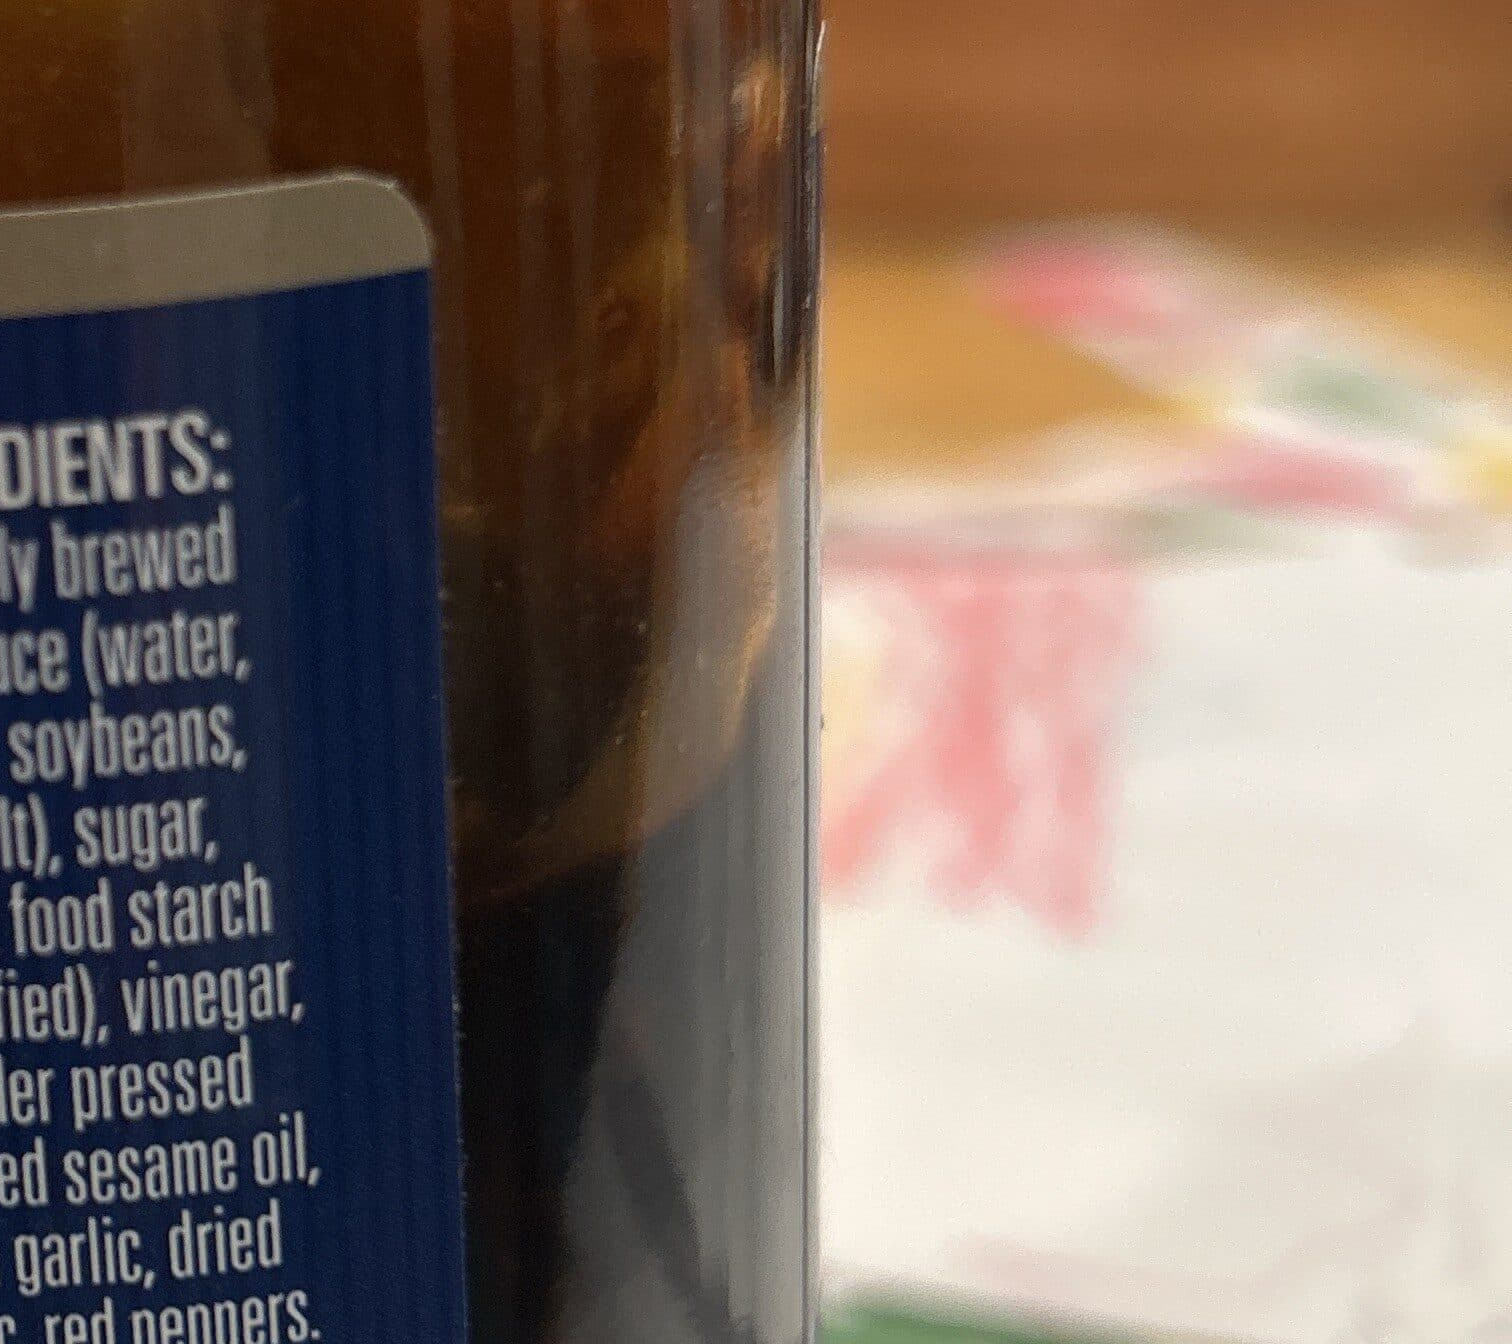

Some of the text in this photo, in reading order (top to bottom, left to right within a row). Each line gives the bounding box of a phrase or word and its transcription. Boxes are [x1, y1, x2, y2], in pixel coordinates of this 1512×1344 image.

[51, 503, 238, 600] brewed
[81, 609, 252, 700] (water,
[8, 701, 248, 790] soybeans,
[74, 796, 219, 872] sugar,
[8, 877, 115, 956] food
[128, 860, 275, 949] starch
[121, 959, 306, 1035] vinegar,
[70, 1035, 254, 1132] pressed
[63, 1134, 239, 1206] sesame
[252, 1111, 322, 1187] oil,
[14, 1216, 157, 1297] garlic,
[168, 1199, 282, 1281] dried
